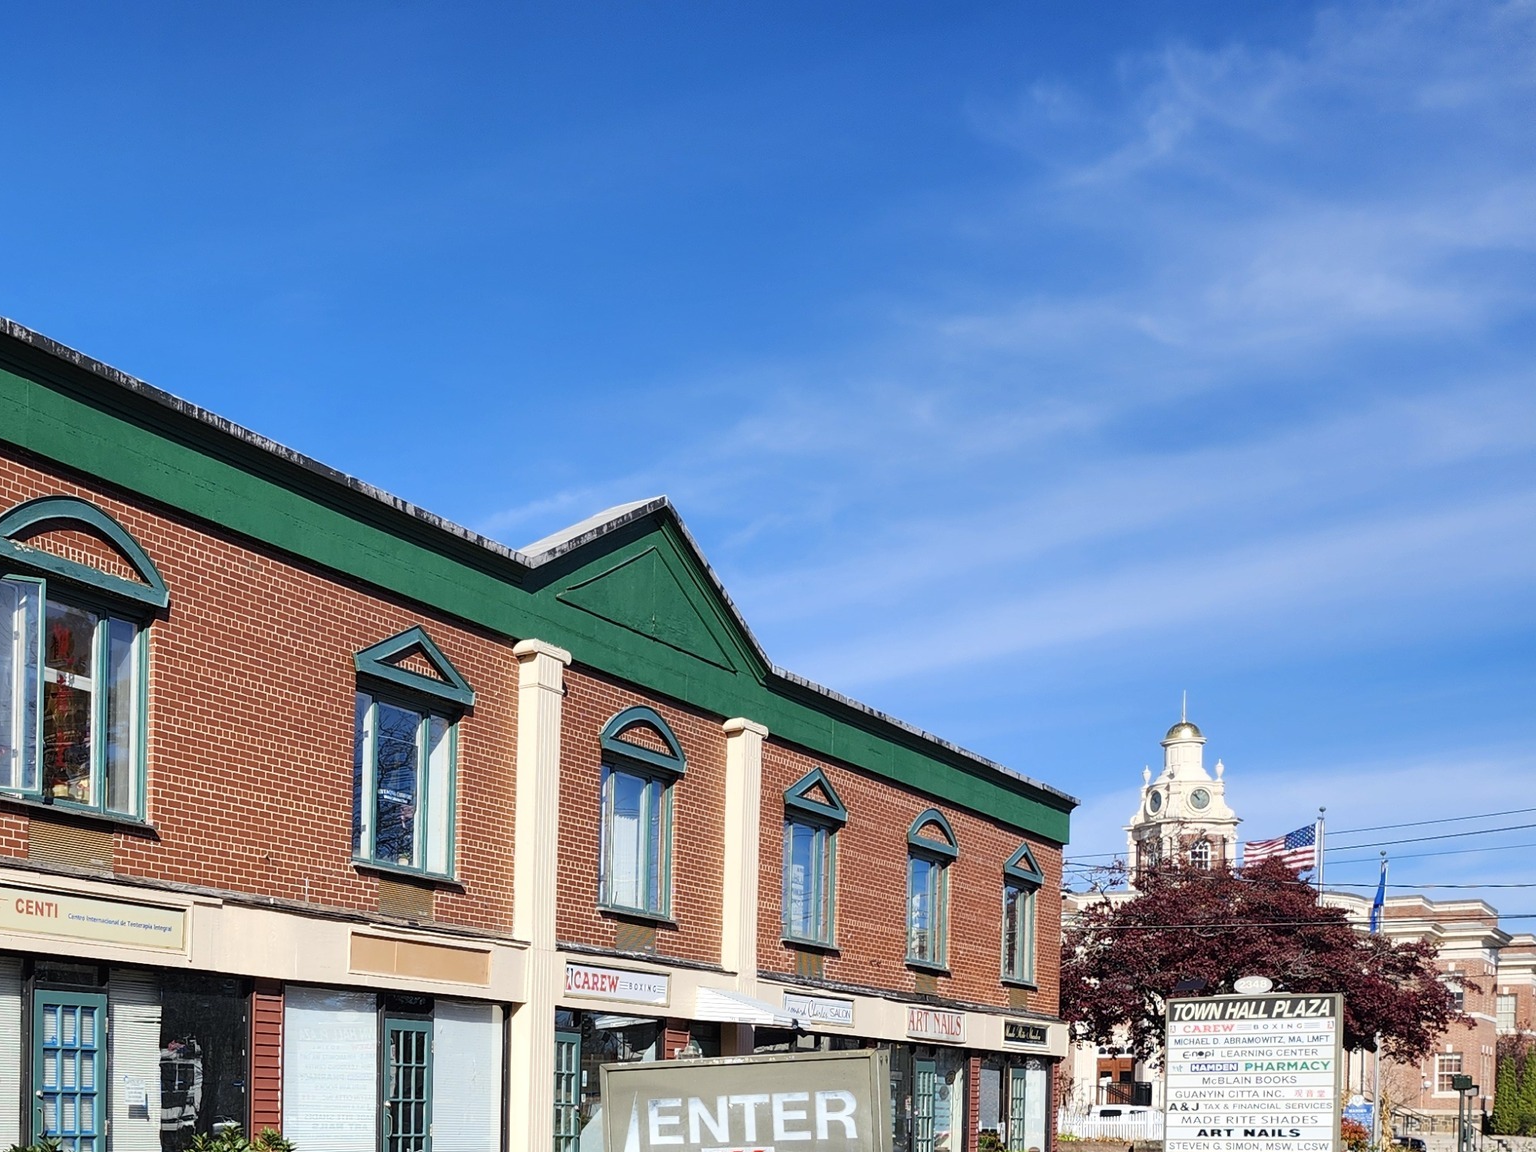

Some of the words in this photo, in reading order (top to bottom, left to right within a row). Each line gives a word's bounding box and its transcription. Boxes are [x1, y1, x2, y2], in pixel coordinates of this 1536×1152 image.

[14, 897, 58, 918] CENTI
[68, 913, 85, 921] Centro
[86, 915, 119, 925] Internacional
[574, 970, 619, 993] CAREW
[629, 982, 656, 993] BOXING
[1240, 980, 1267, 989] 2348
[830, 1008, 850, 1018] SALON
[1173, 1002, 1224, 1021] TOWN
[1225, 1001, 1268, 1019] HALL
[1271, 999, 1330, 1018] PLAZA
[907, 1010, 929, 1032] ART
[933, 1013, 961, 1036] NAILS
[1183, 1024, 1235, 1033] CAREW
[1174, 1037, 1210, 1045] MICHAEL
[1223, 1036, 1285, 1045] ABRAMOWITZ,
[1220, 1049, 1273, 1058] LEARNING
[1191, 1063, 1237, 1072] HAMDEN
[1245, 1061, 1331, 1071] PHARMACY
[1202, 1076, 1252, 1085] McBLAIN
[1256, 1076, 1297, 1084] BOOKS
[1228, 1090, 1259, 1098] CITTA
[1168, 1103, 1200, 1111] A&J
[647, 1090, 858, 1145] ENTER
[1181, 1116, 1221, 1124] MADE
[1226, 1116, 1256, 1124] RITE
[1261, 1116, 1318, 1124] SHADES
[1197, 1129, 1234, 1137] ART
[1243, 1129, 1301, 1137] NAILS
[1169, 1142, 1210, 1150] STEVEN
[1225, 1142, 1262, 1151] SIMON,
[1265, 1142, 1293, 1151] MSW,
[1297, 1142, 1329, 1150] LCSW
